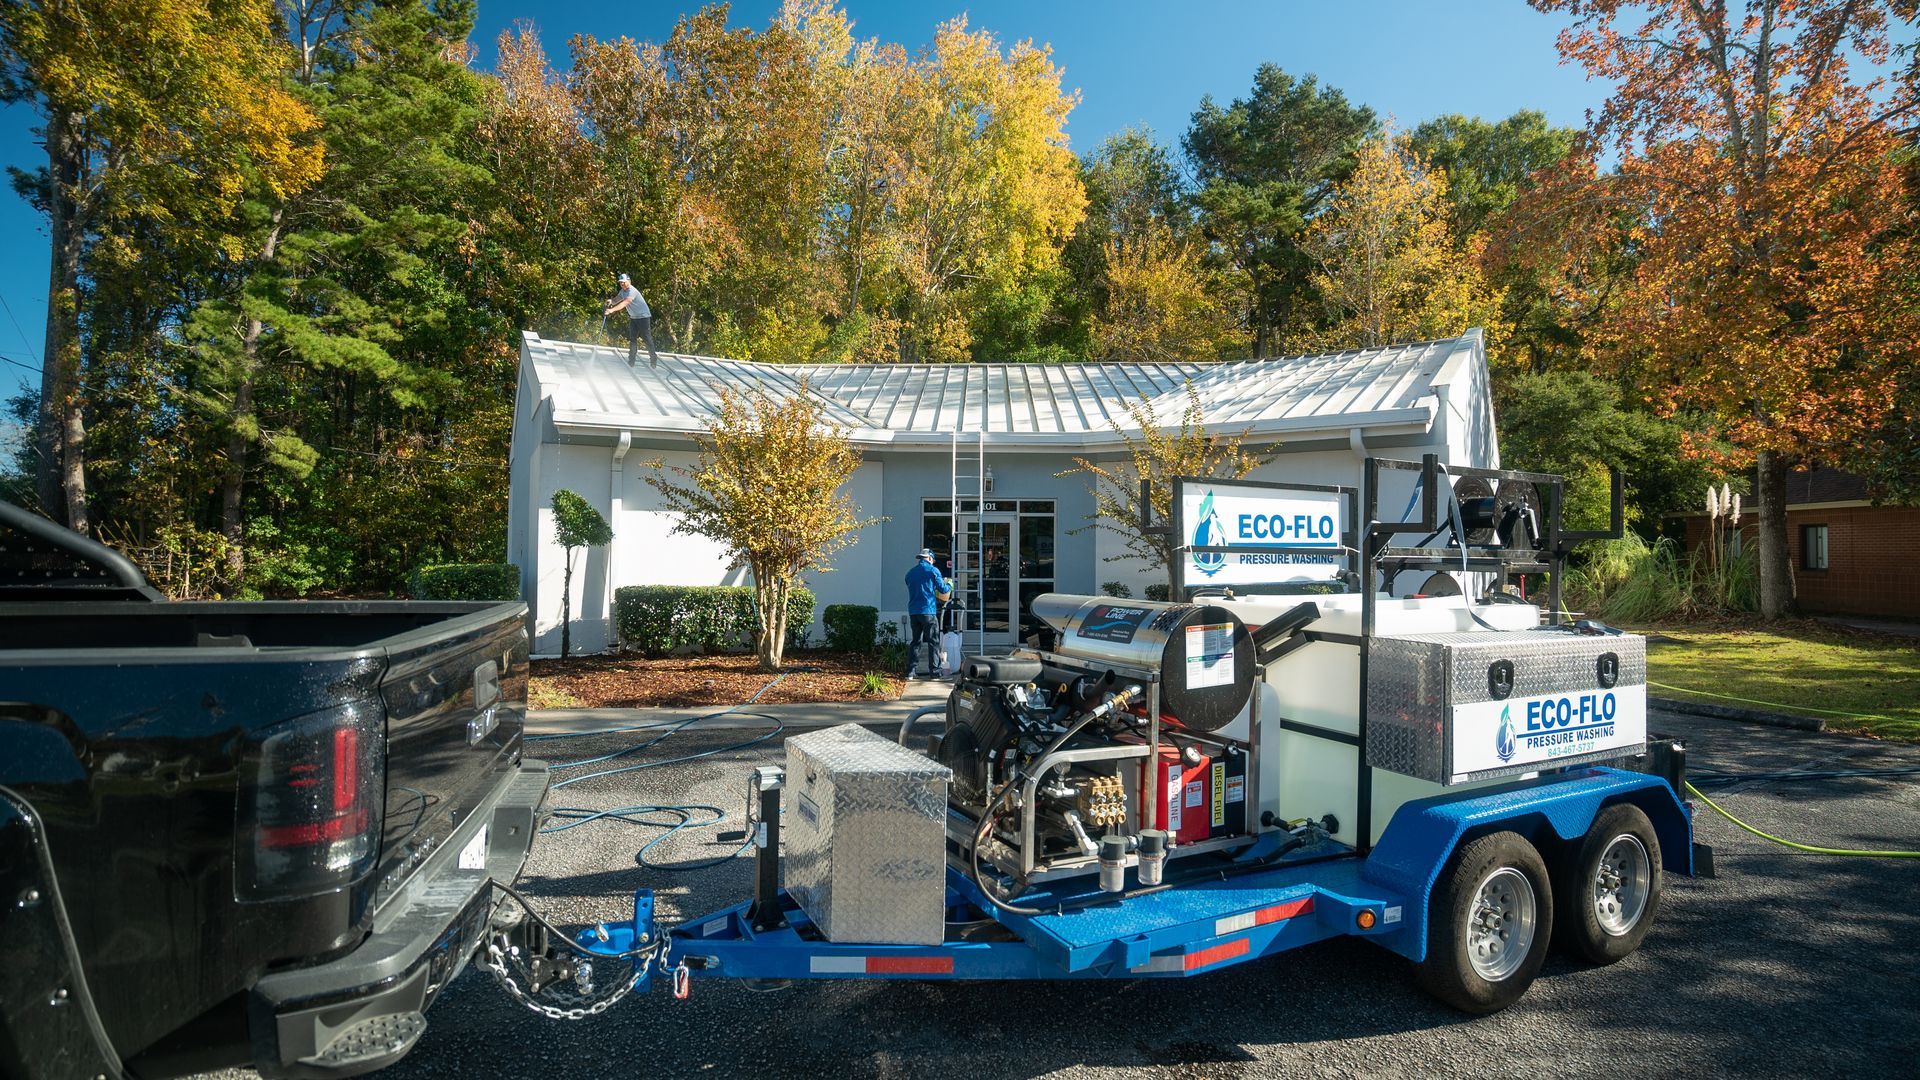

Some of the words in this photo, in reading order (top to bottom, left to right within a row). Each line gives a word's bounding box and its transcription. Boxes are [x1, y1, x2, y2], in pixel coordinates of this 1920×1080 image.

[1238, 514, 1334, 539] ECO-FLO
[1239, 554, 1290, 565] PRESSURE
[1292, 554, 1334, 564] WASHING
[1110, 607, 1144, 616] POWER
[1527, 692, 1616, 731] ECO-FLO
[1527, 732, 1574, 749] PRESSURE
[1576, 726, 1615, 741] WASHING
[1547, 741, 1594, 757] 843-467-5737
[1214, 765, 1223, 798] DIESEL
[1171, 774, 1179, 822] GASOLINE
[1214, 800, 1222, 824] FUEL
